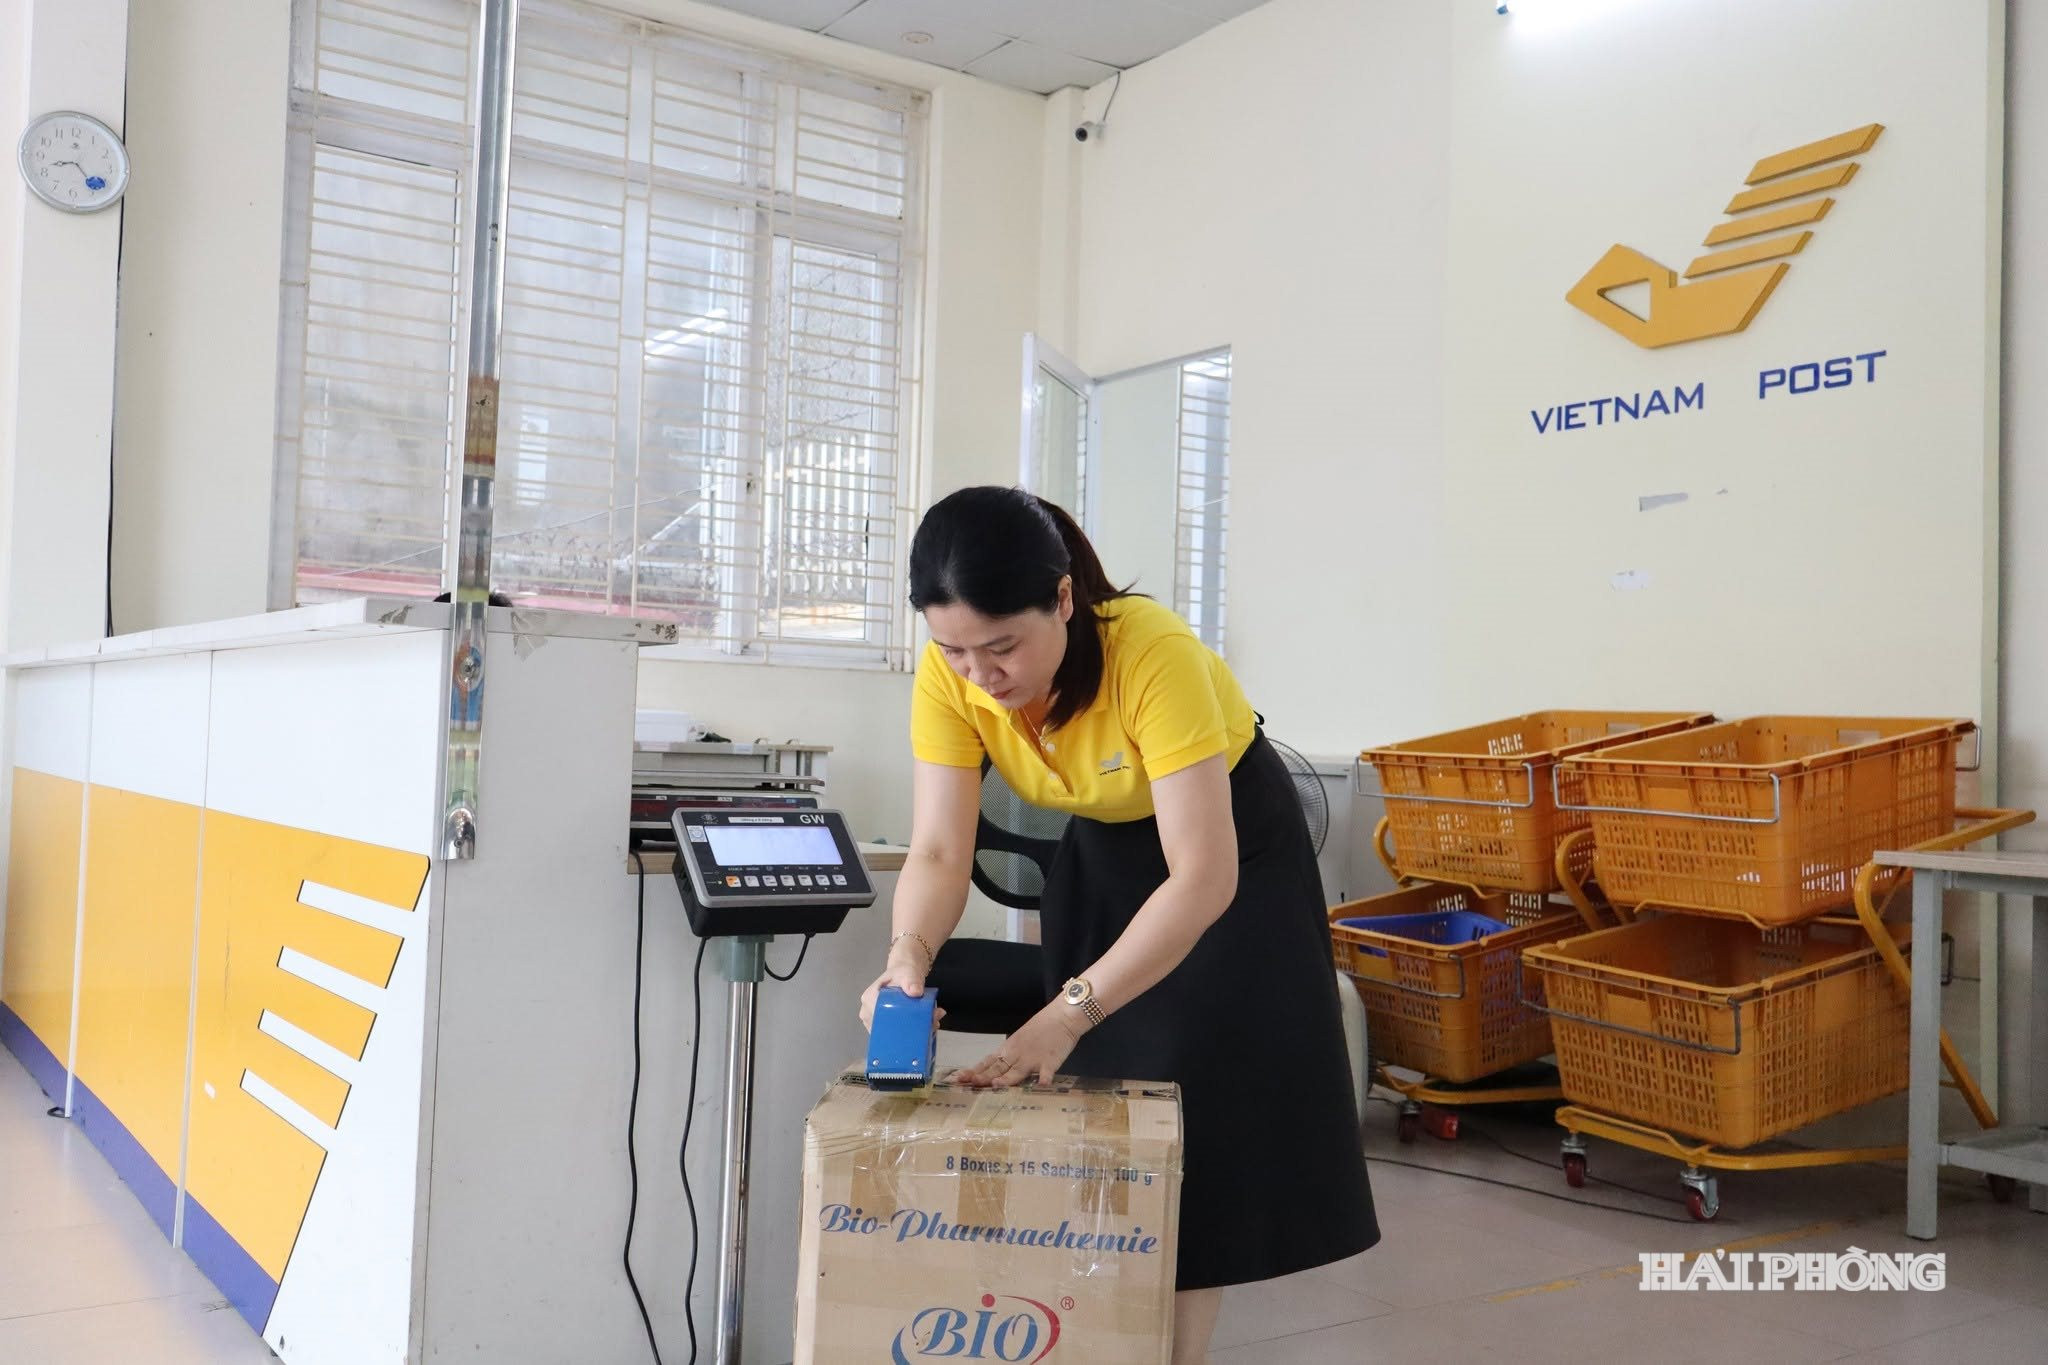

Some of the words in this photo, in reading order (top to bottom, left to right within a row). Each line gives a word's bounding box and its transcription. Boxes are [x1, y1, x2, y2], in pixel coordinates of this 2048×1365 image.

[1531, 382, 1705, 434] VIETNAM
[1758, 350, 1887, 400] POST
[799, 813, 826, 825] GW
[946, 1156, 954, 1170] 8
[1005, 1162, 1013, 1174] x
[1019, 1161, 1035, 1175] 15
[819, 1203, 1161, 1255] Bio-Pharmachemie
